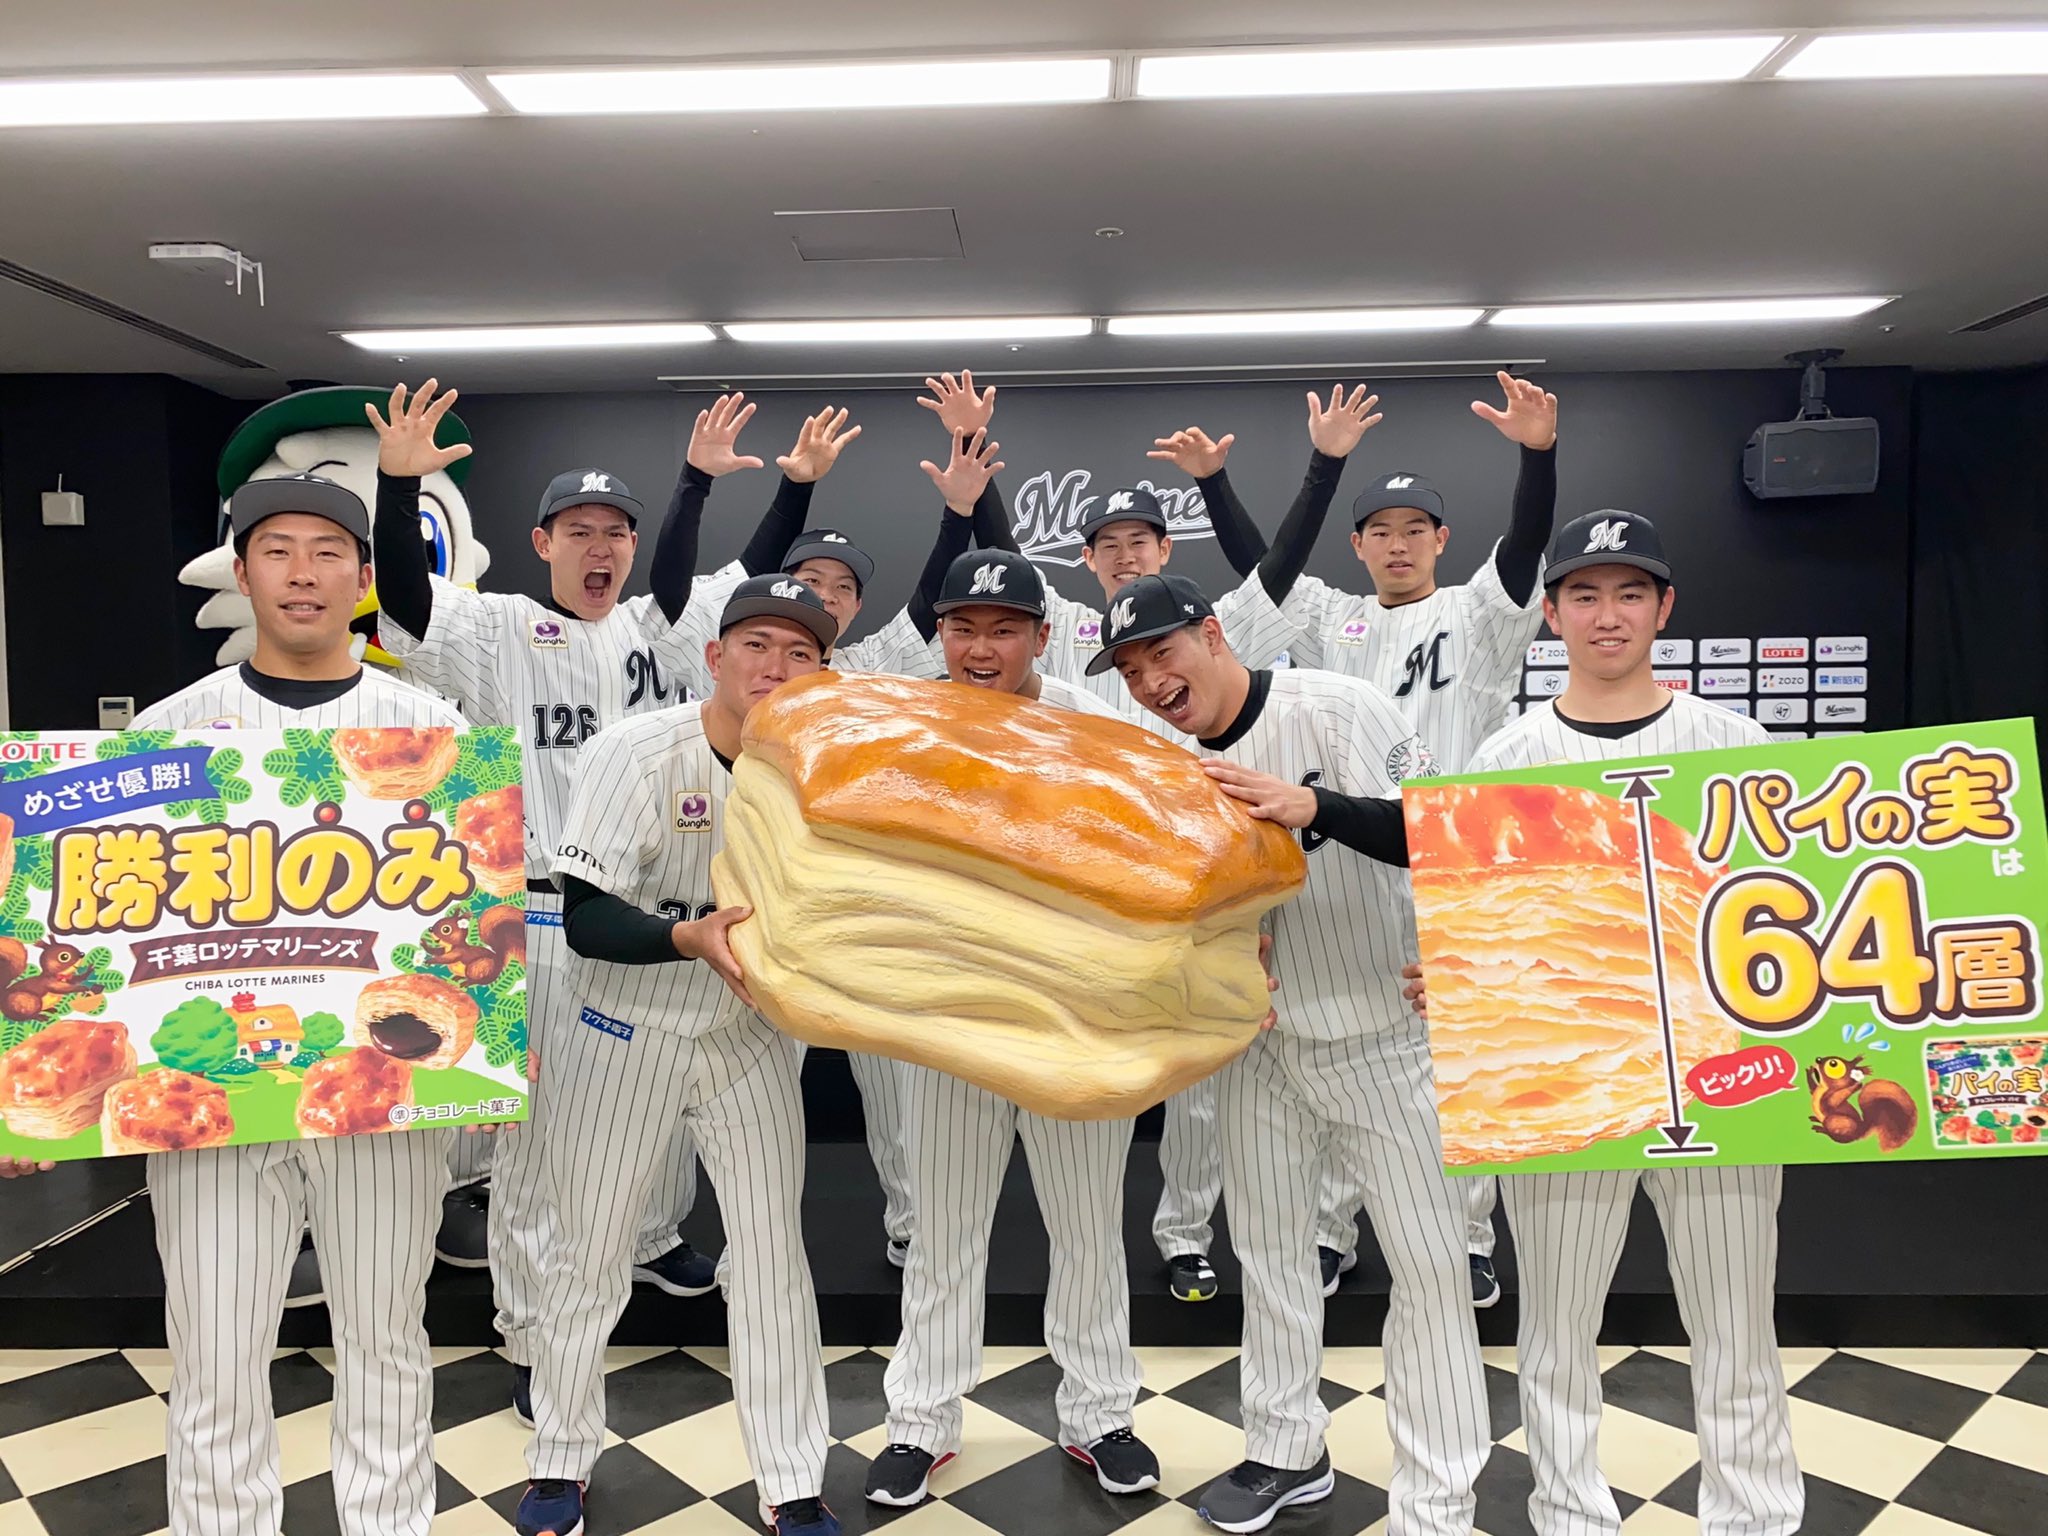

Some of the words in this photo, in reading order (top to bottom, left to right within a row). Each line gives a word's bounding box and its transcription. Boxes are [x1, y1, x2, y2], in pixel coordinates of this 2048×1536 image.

[579, 472, 611, 493] M
[1106, 491, 1134, 514] M
[1584, 519, 1629, 553] M
[969, 563, 1008, 594] M
[1110, 597, 1136, 639] M
[533, 637, 566, 646] GungHo
[1547, 649, 1569, 657] ZOZ
[1763, 649, 1803, 657] LOTTE
[1392, 630, 1456, 699] M
[1655, 681, 1686, 689] OTTE
[1718, 676, 1747, 685] GungHo
[1778, 677, 1805, 685] ZOZO
[533, 704, 598, 750] 126
[0, 743, 86, 760] OTTE
[1698, 747, 2014, 863] パイの実
[677, 817, 711, 829] GungHo
[48, 801, 476, 935] 勝利のみ
[557, 845, 608, 875] LOTTE
[1992, 848, 2025, 877] は
[525, 912, 563, 924] フクダ電
[147, 936, 363, 970] 千葉ロッテマリーンズ
[1702, 862, 2036, 1032] 64層
[185, 979, 223, 991] CHIBA
[228, 977, 267, 988] LOTTE
[271, 974, 325, 986] MARINES
[1951, 1067, 2042, 1097] パイの実
